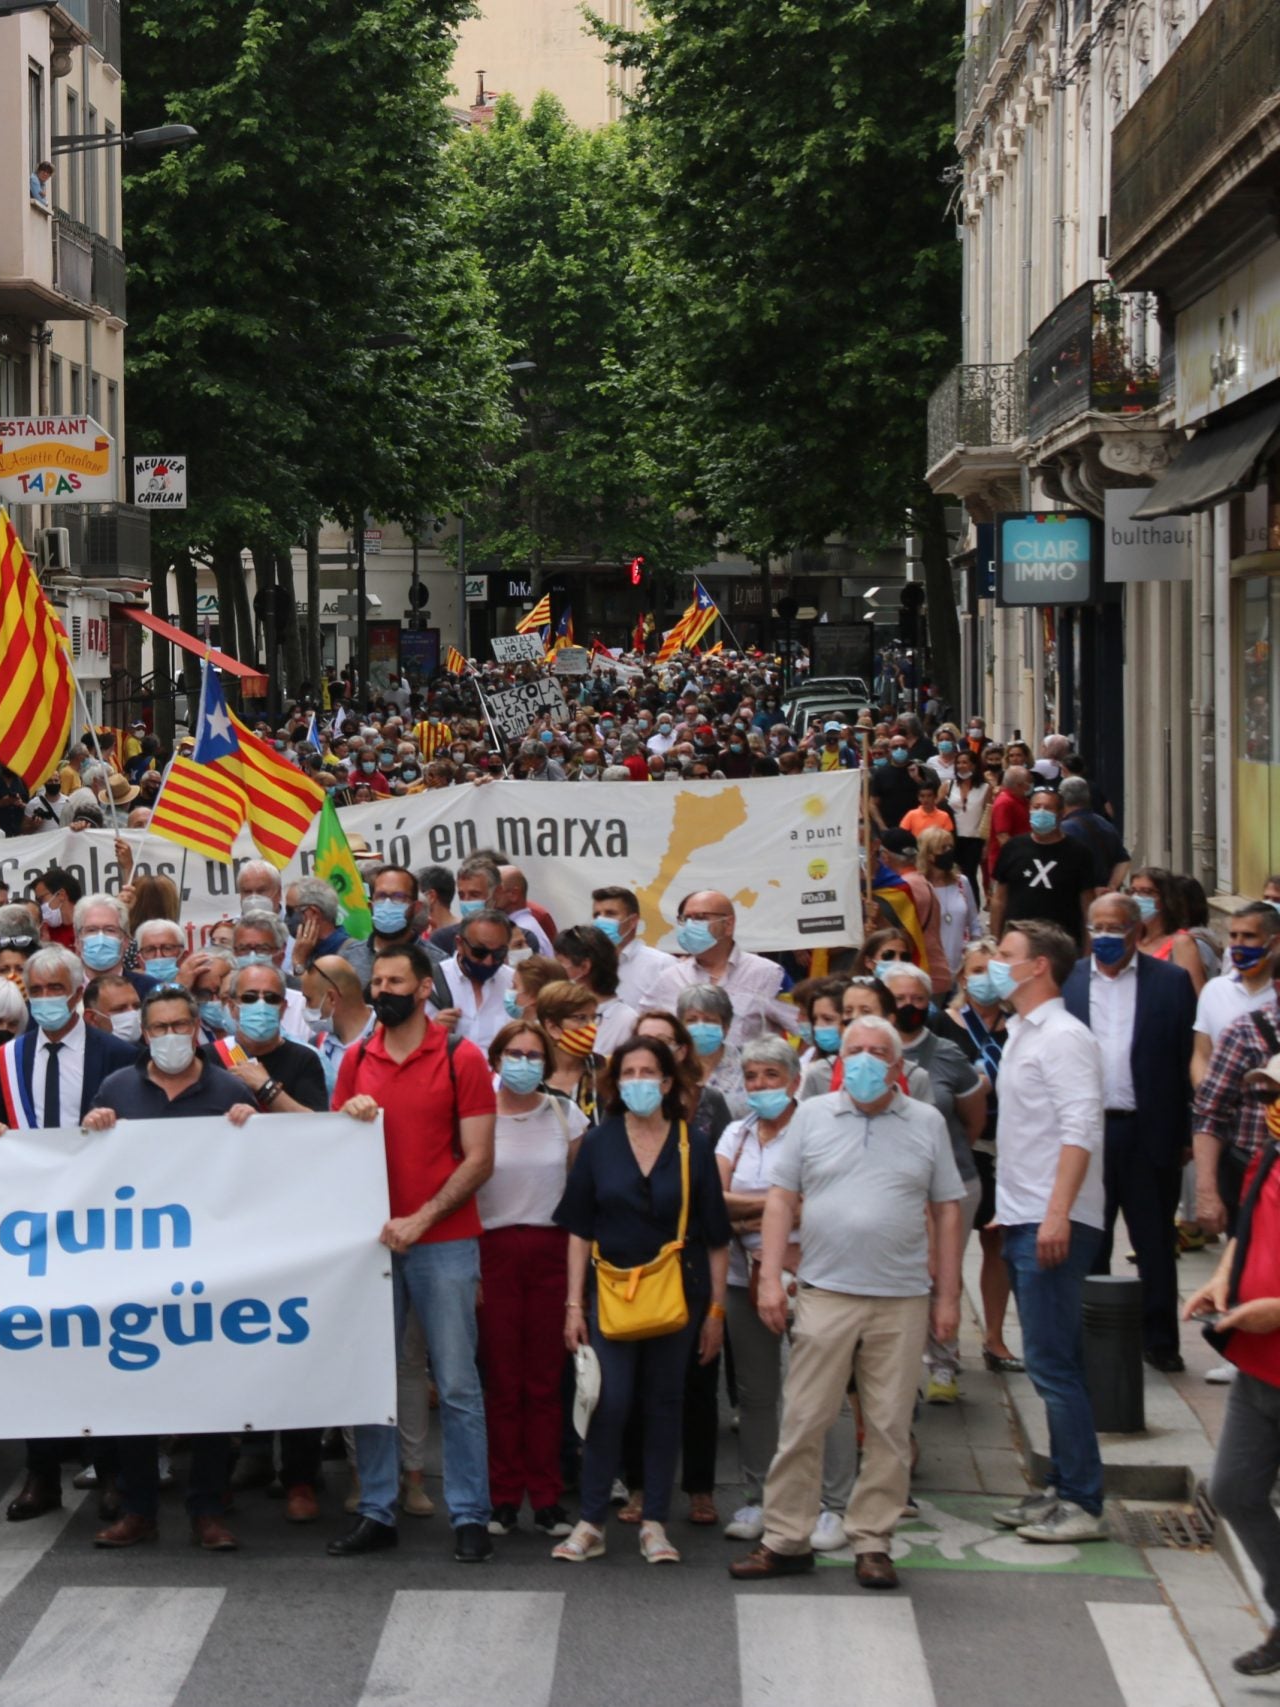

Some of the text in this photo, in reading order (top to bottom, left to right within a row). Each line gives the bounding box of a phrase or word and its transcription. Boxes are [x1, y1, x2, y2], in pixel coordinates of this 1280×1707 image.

[135, 458, 185, 475] MEUNIER
[18, 472, 82, 497] TAPAS
[138, 492, 183, 503] CATALAN
[1013, 540, 1079, 560] CLAIR
[1014, 562, 1077, 581] IMMO
[429, 818, 477, 863] en
[496, 816, 629, 858] marxa
[790, 825, 843, 842] a punt
